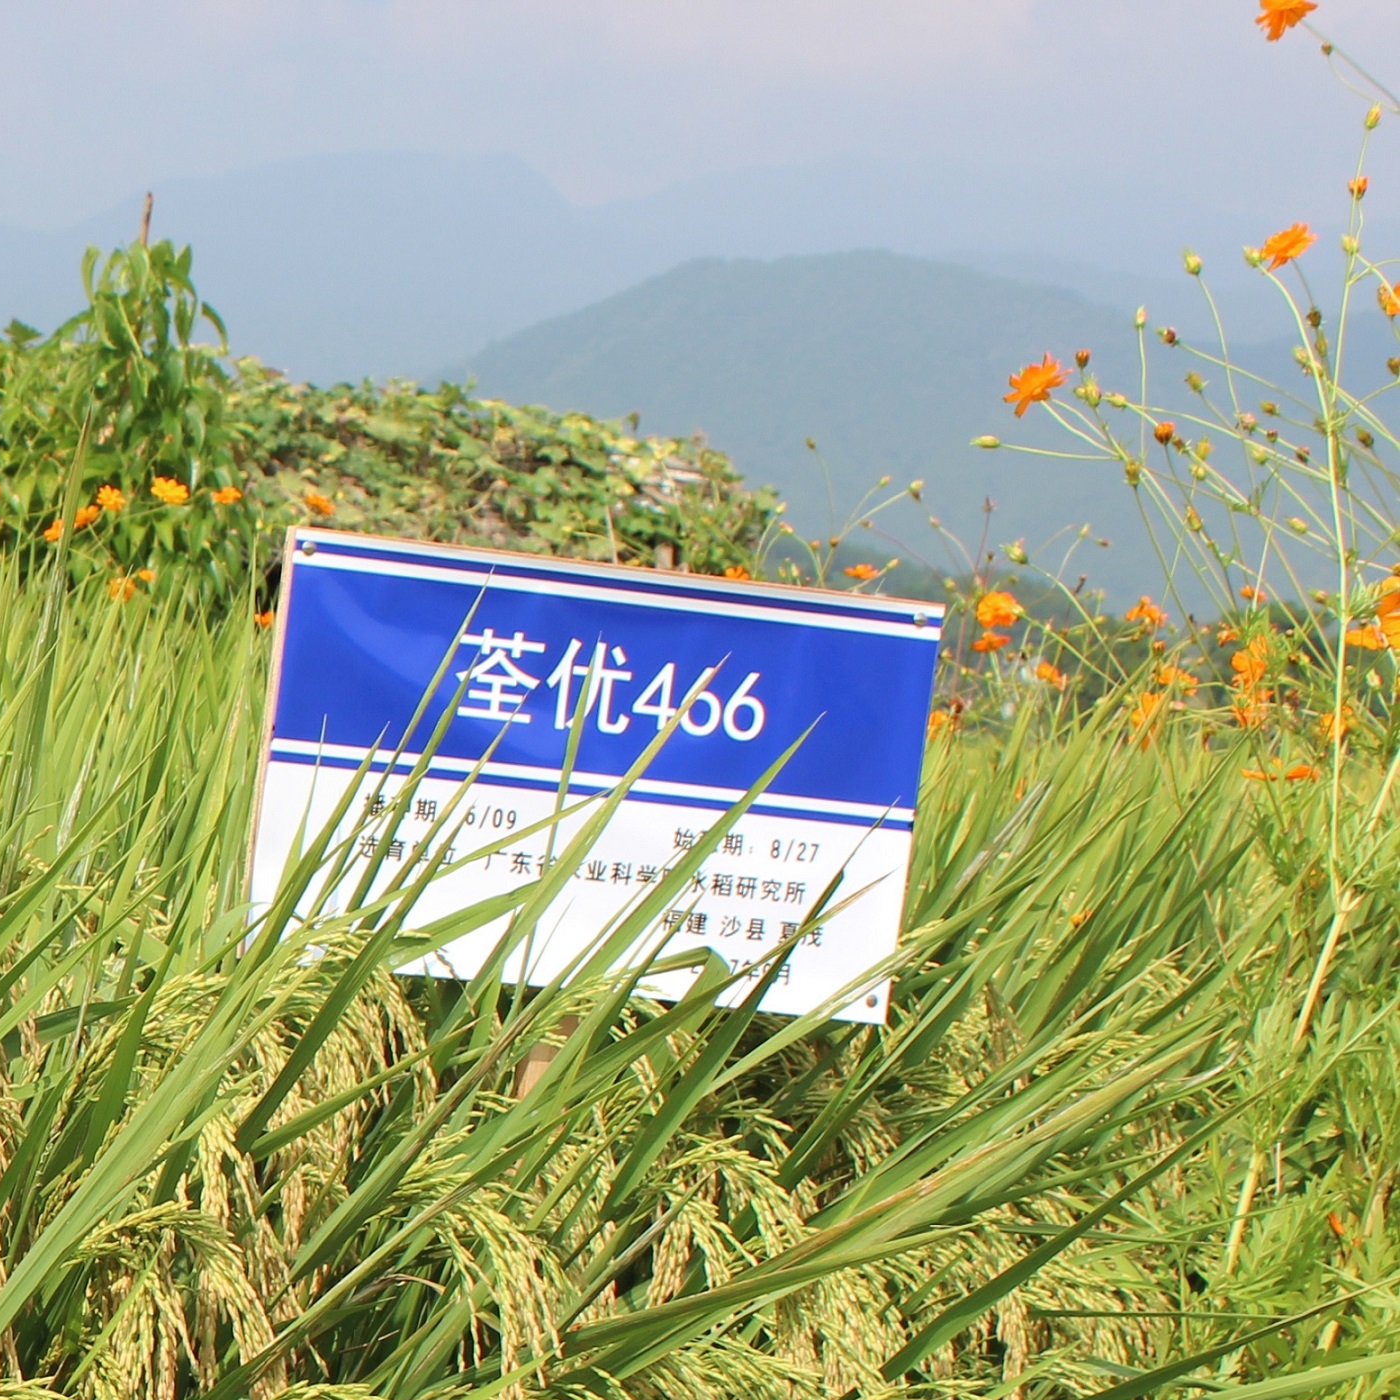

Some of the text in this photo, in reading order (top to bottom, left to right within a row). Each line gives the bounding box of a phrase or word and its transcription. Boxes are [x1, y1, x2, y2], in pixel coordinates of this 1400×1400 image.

[455, 627, 768, 742] 荃优466
[363, 792, 517, 830] 播期 6/09
[672, 826, 821, 863] 始期： 8/27
[483, 849, 807, 905] 广东业科学水稻研究所
[719, 914, 766, 941] 沙县
